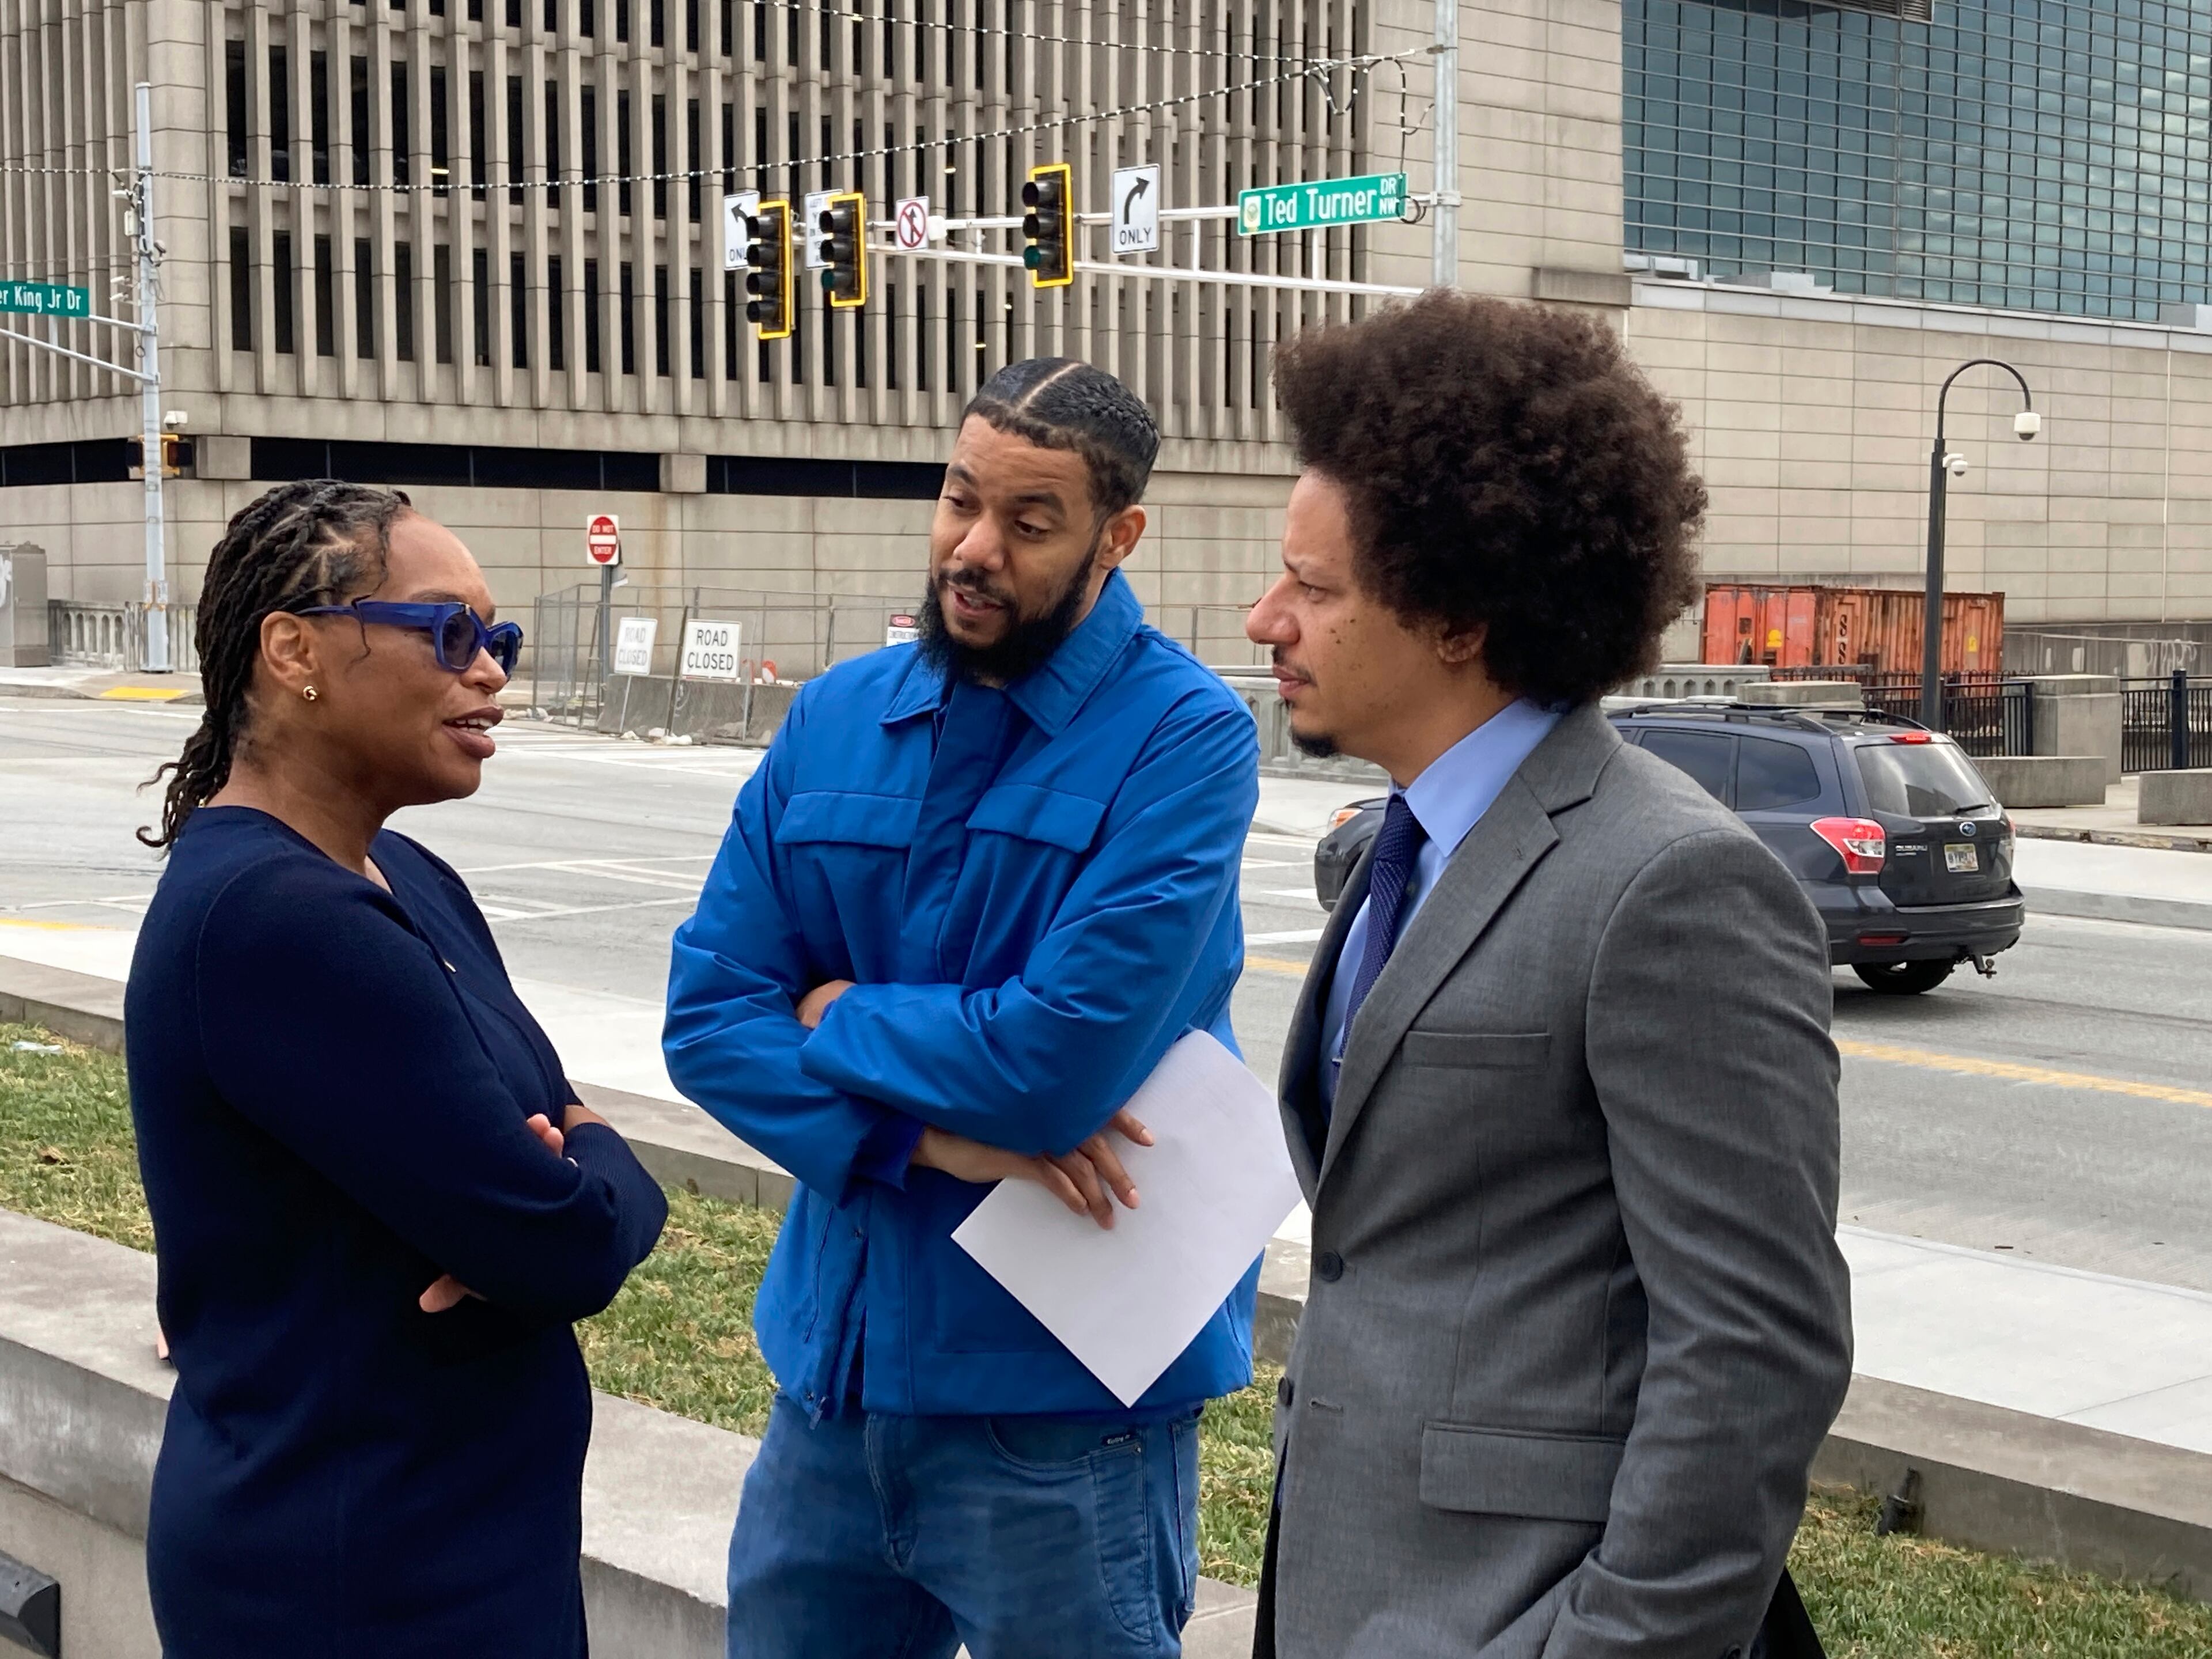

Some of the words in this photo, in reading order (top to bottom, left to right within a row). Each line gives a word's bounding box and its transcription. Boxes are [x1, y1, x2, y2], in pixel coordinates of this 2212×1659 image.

[1380, 177, 1396, 195] DR
[1265, 192, 1297, 225] Ted
[1306, 188, 1377, 221] Turner
[1379, 198, 1397, 215] NW
[1120, 227, 1152, 245] ONLY
[729, 248, 747, 262] ONL
[14, 286, 43, 313] King
[47, 289, 61, 309] Jr
[67, 289, 81, 310] Dr
[592, 525, 600, 533] DO
[603, 525, 614, 533] NOT
[594, 546, 612, 555] ENTER
[624, 627, 646, 643] ROAD
[696, 629, 728, 646] ROAD
[618, 649, 648, 666] CLOSED
[687, 652, 734, 671] CLOSED
